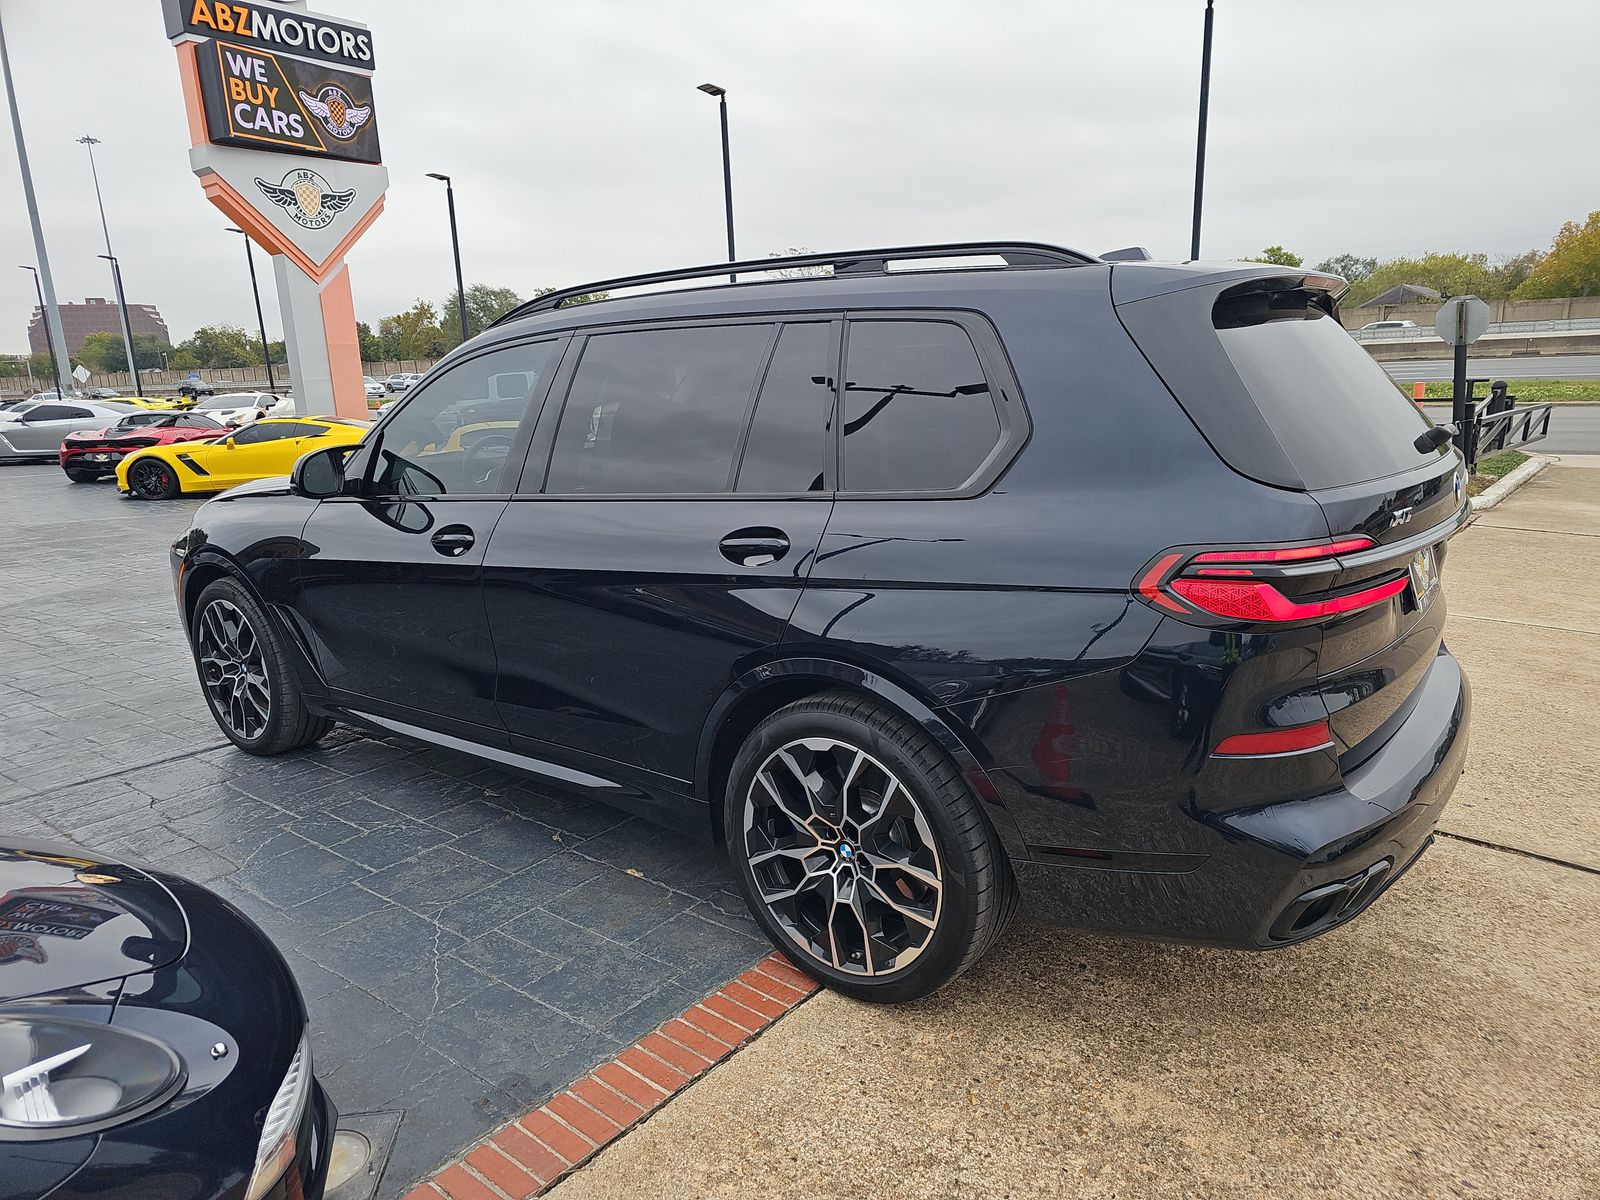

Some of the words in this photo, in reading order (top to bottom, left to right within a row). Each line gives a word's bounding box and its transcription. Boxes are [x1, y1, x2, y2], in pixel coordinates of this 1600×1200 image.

[225, 51, 268, 83] WE
[229, 77, 279, 109] BUY
[234, 103, 305, 138] CARS
[327, 122, 354, 136] MOTORS
[297, 171, 315, 181] ABZ
[293, 212, 331, 227] MOTORS
